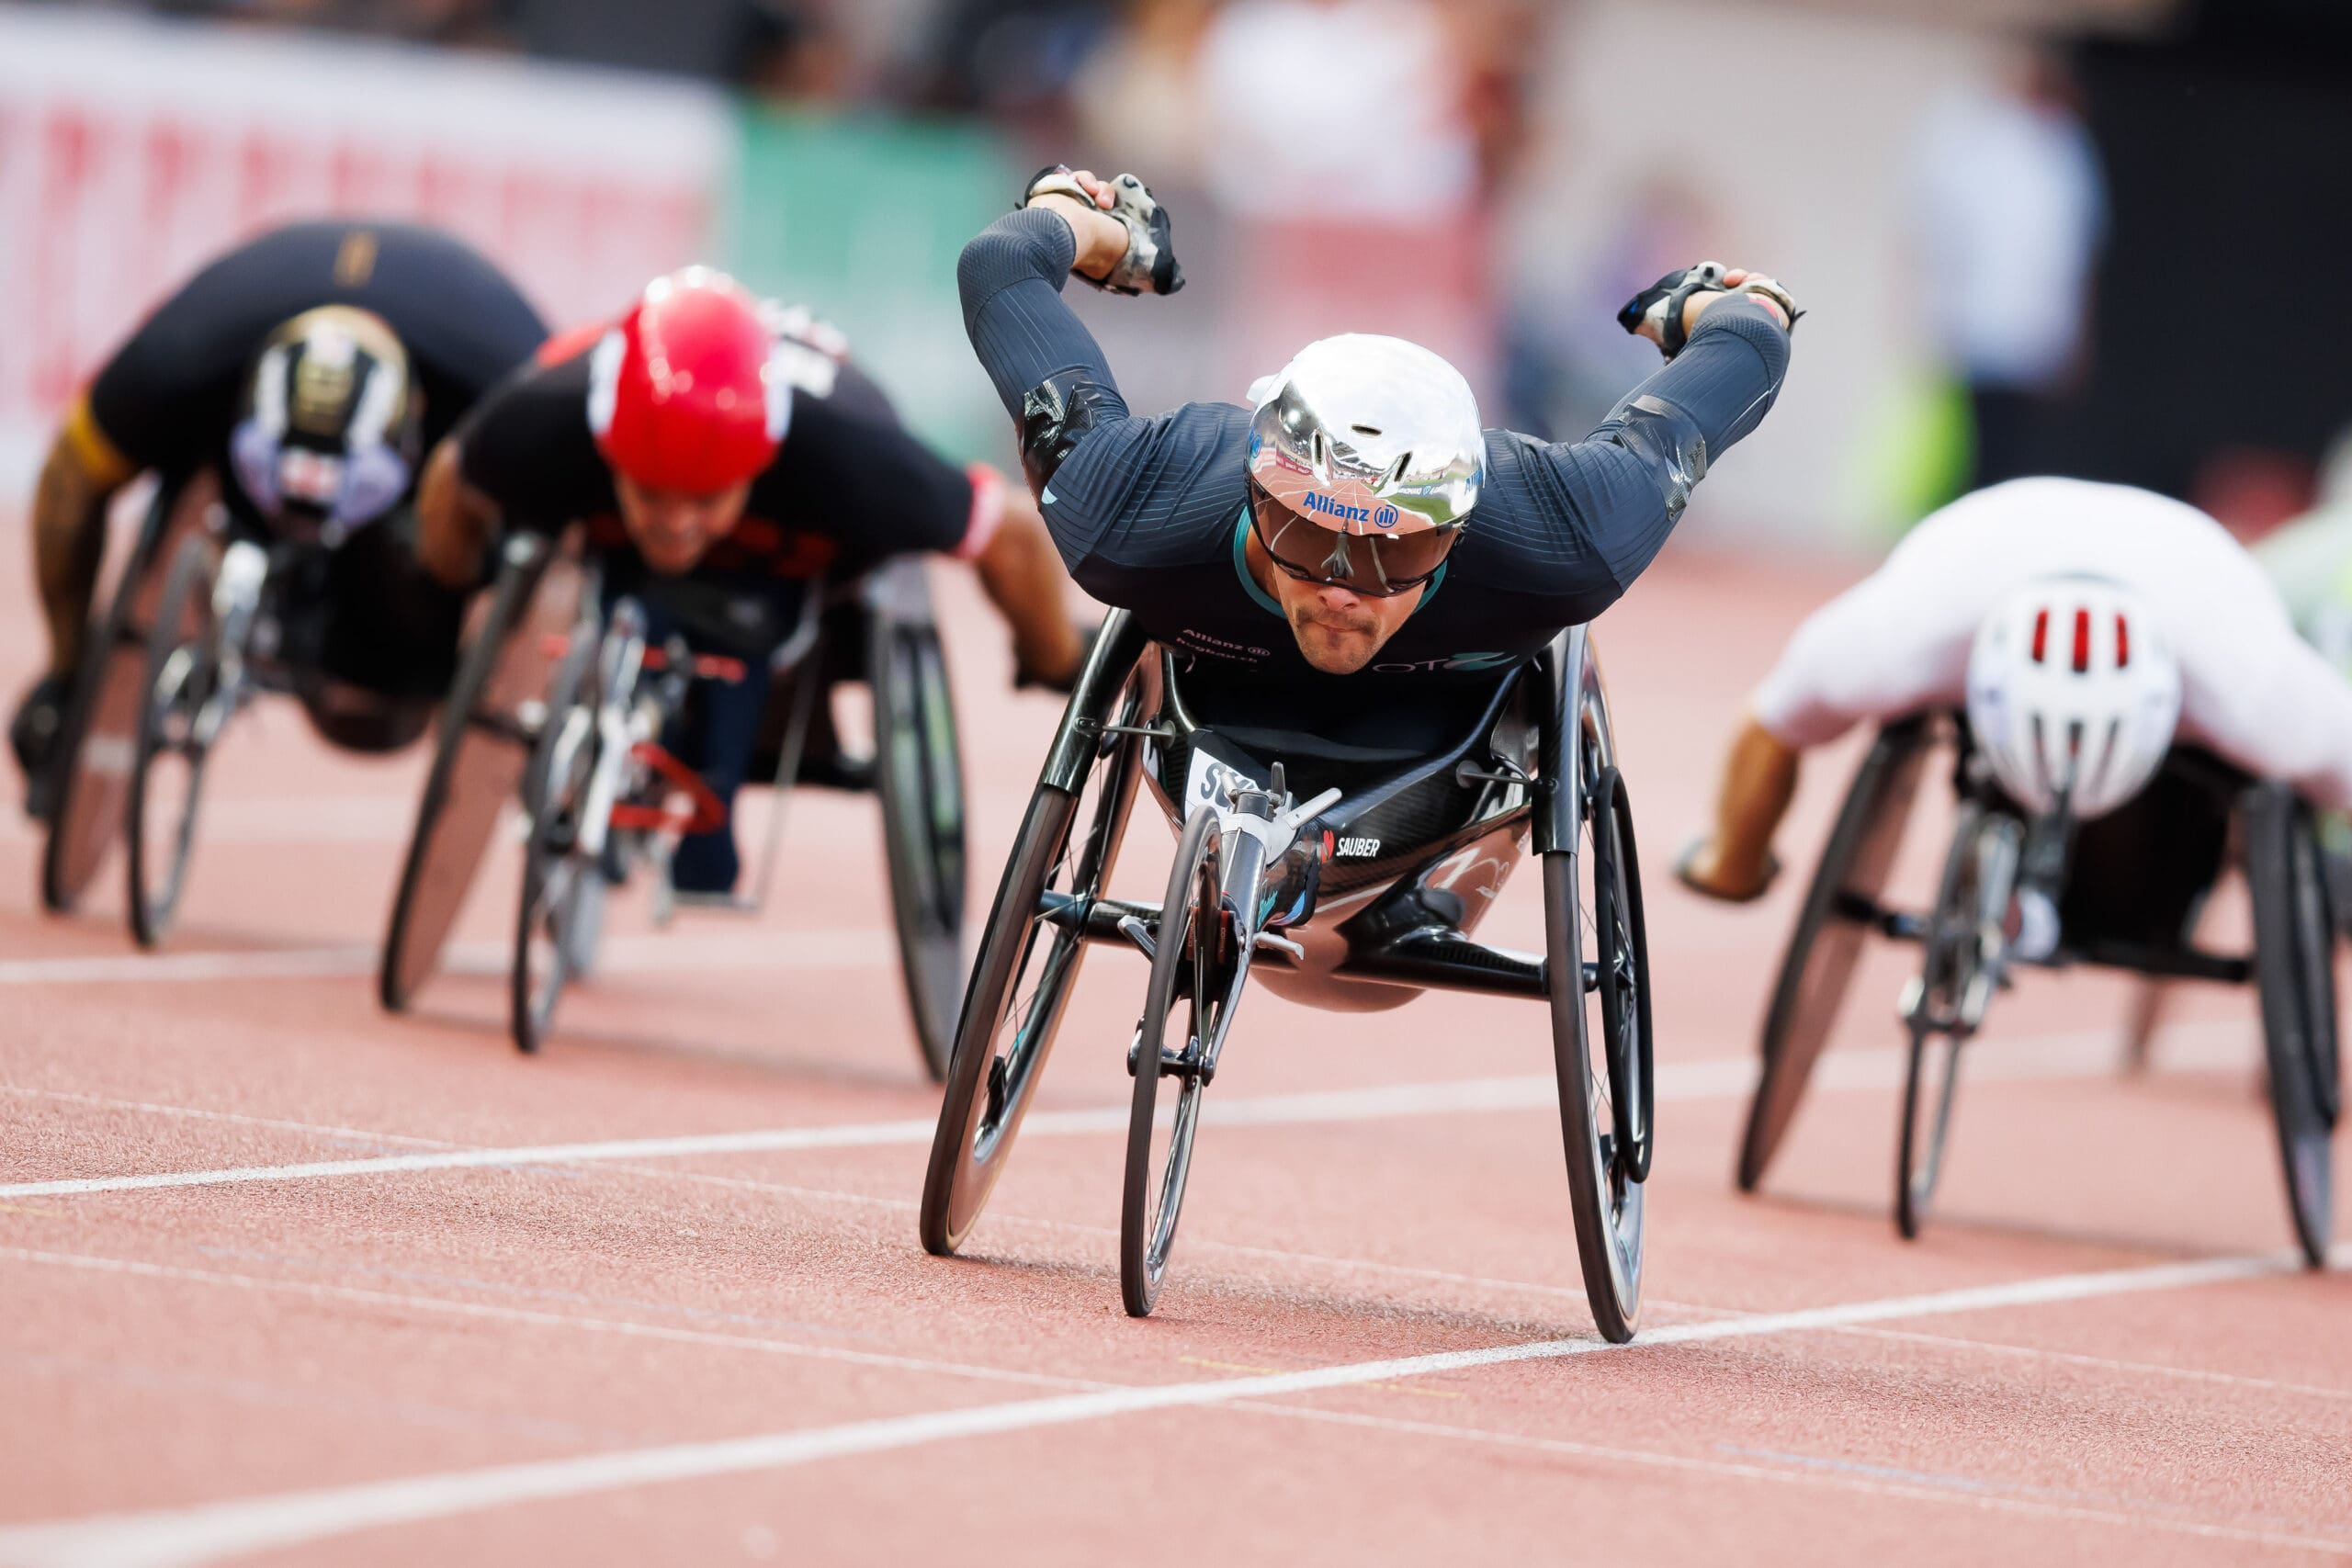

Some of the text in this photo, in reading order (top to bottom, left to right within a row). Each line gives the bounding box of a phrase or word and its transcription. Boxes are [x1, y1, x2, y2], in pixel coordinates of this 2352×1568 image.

[1303, 491, 1370, 523] Allianz
[1182, 629, 1244, 651] Allianz
[1336, 837, 1381, 858] SAUBER
